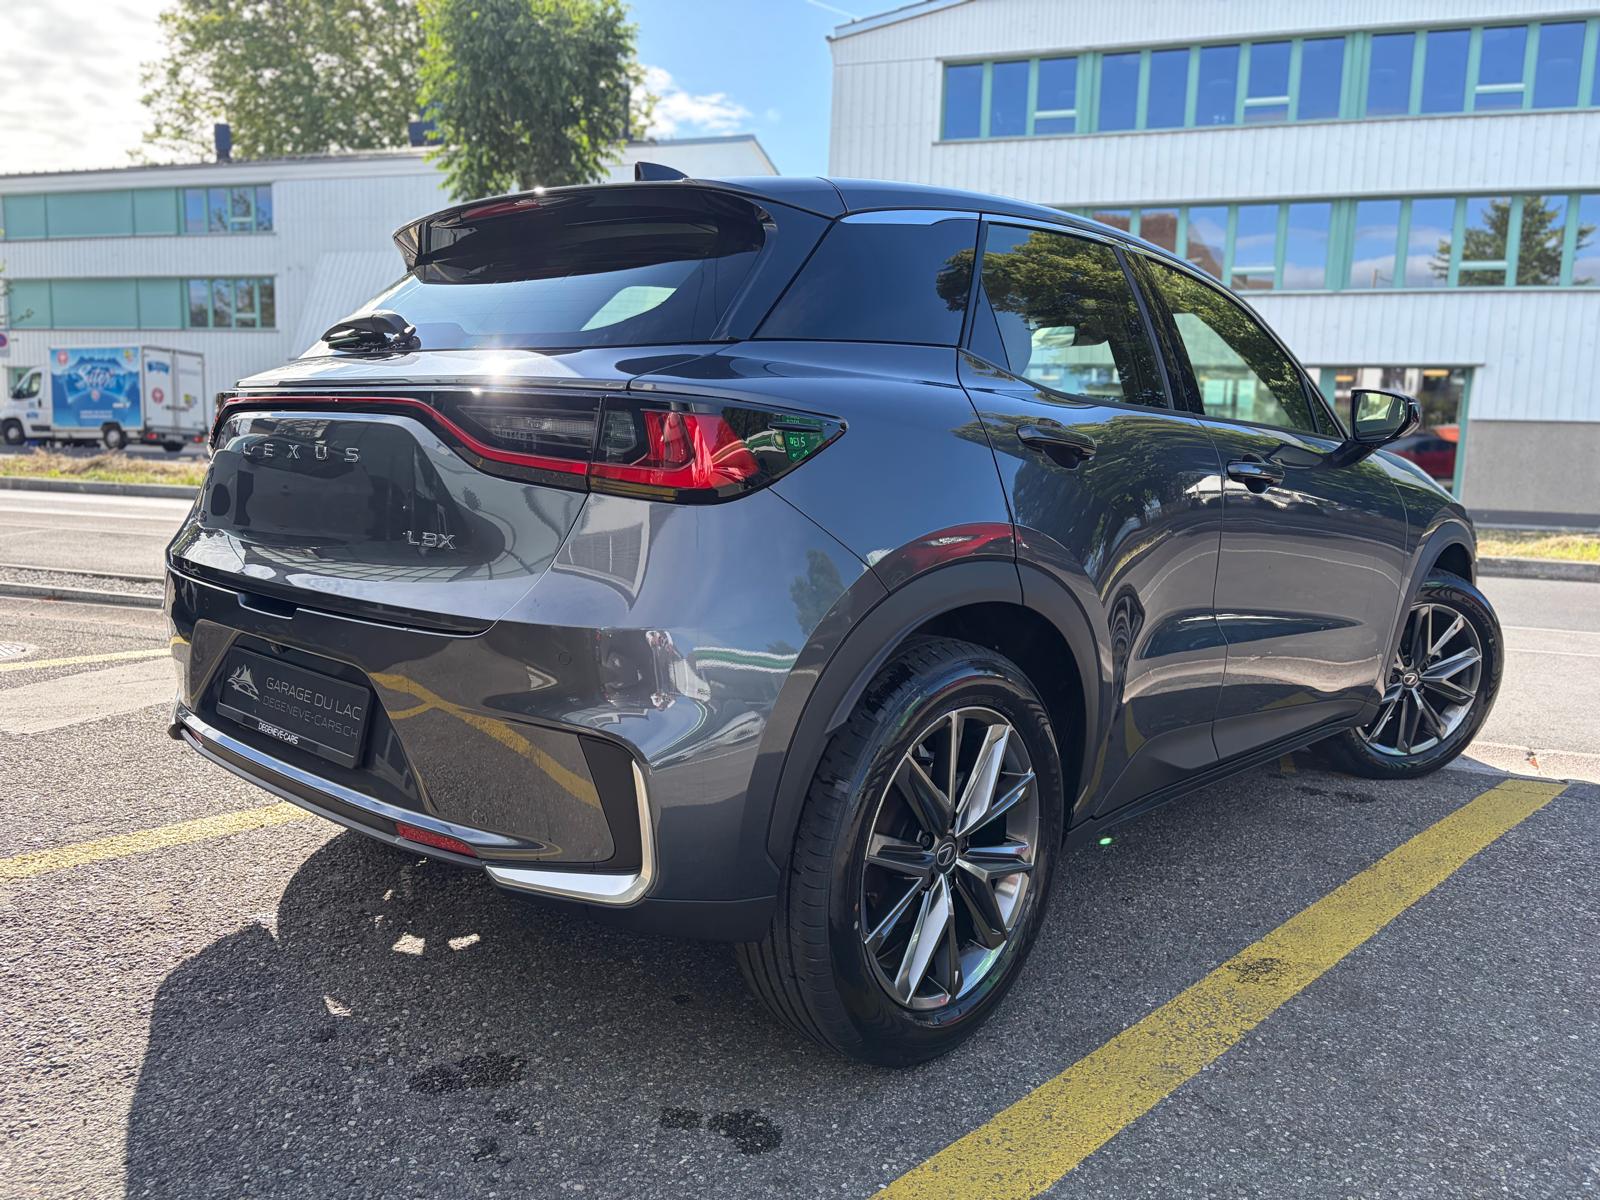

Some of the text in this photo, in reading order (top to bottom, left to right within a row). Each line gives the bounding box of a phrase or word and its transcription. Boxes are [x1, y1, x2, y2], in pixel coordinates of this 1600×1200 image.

[243, 443, 360, 463] LEXUS
[407, 531, 455, 549] LBX
[266, 677, 362, 721] GARAGE DU LAC
